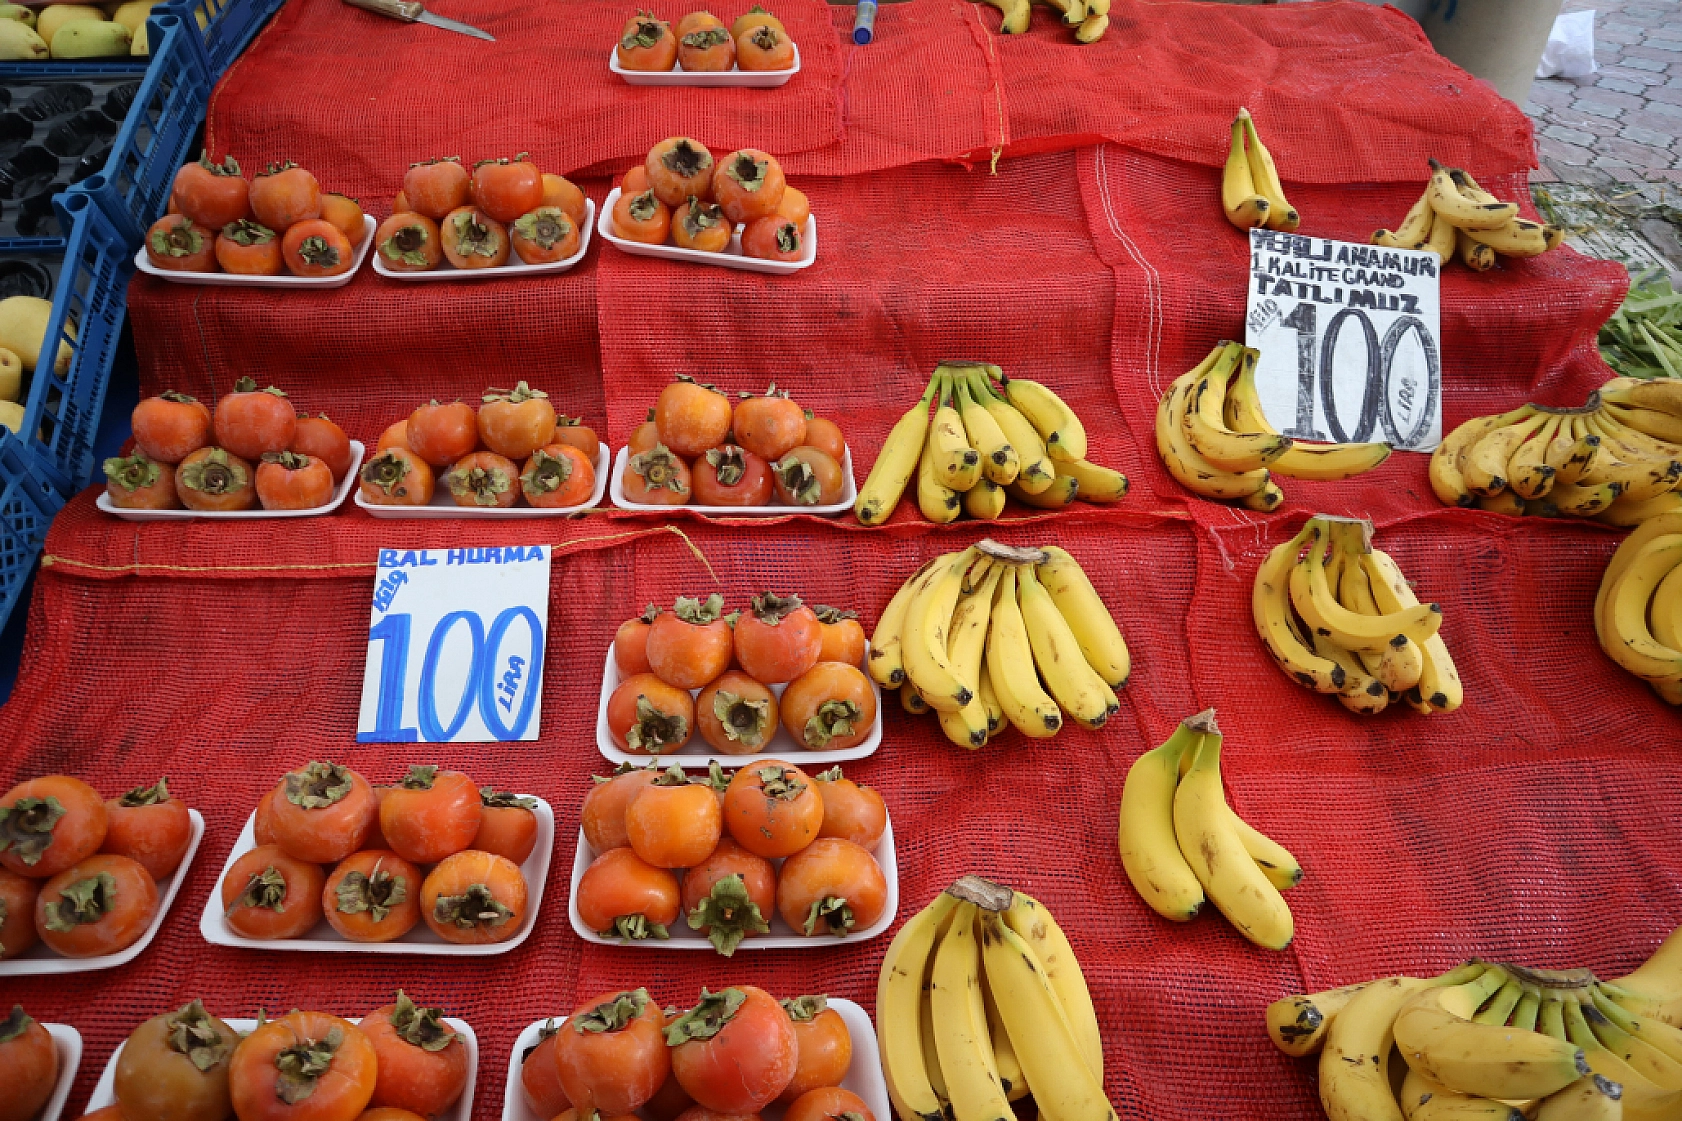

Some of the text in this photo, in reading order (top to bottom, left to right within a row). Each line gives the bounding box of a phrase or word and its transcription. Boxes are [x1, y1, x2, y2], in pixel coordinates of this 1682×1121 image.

[1335, 245, 1436, 278] ANAMUR
[1342, 268, 1405, 289] GRAND
[1254, 273, 1423, 314] TATLI MUZ
[1279, 302, 1439, 448] 100
[378, 545, 545, 567] BAL HURMA
[356, 605, 544, 743] 100
